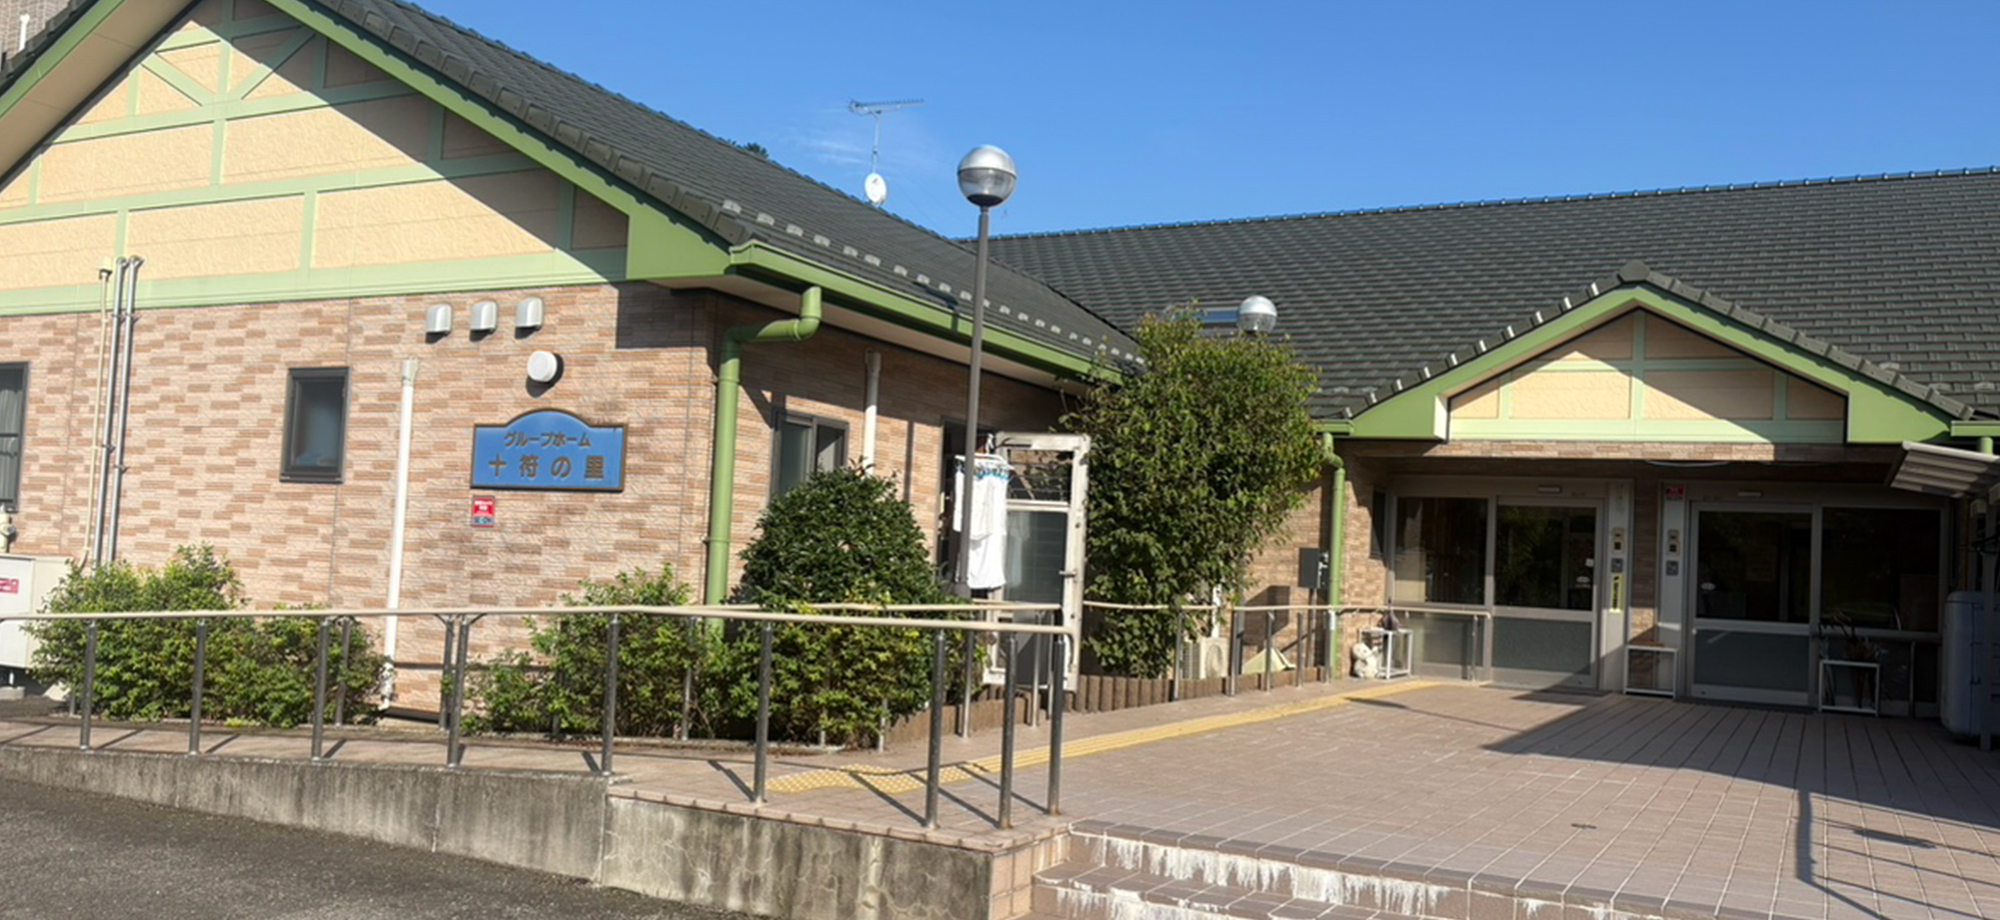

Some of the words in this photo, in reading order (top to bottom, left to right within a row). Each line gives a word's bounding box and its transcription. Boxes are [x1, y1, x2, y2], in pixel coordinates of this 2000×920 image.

[504, 431, 592, 447] グループホーム
[488, 453, 605, 479] 十符の里
